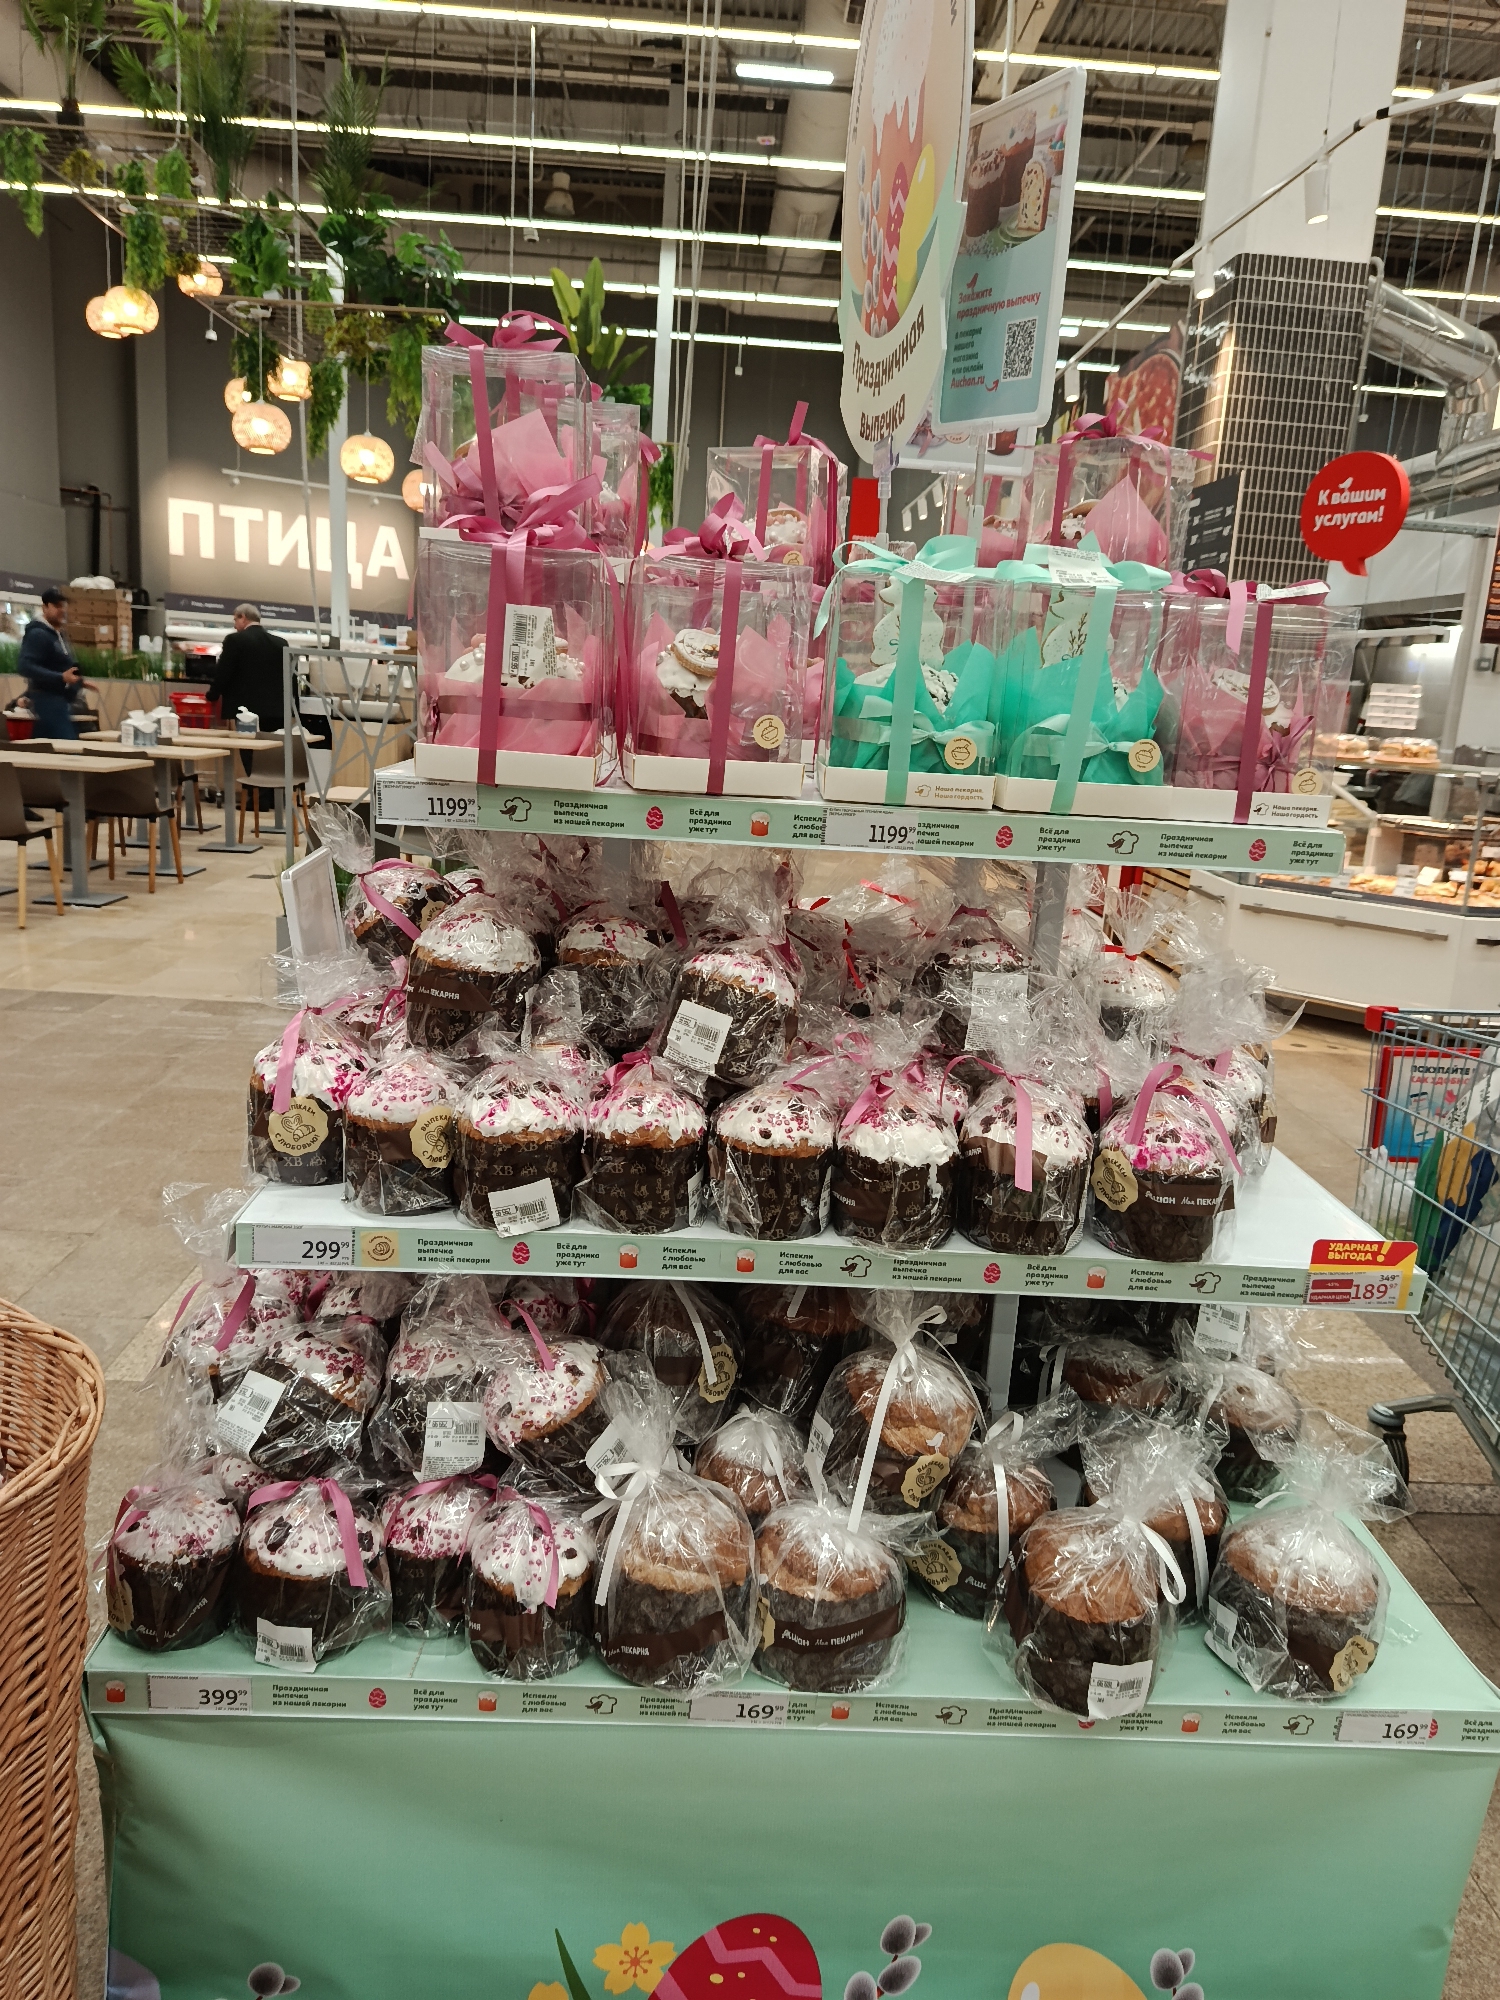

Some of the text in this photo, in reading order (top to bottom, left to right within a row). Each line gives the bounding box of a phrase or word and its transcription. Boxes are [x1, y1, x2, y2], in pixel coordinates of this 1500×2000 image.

[958, 287, 993, 305] Закажите
[956, 291, 1042, 320] праздничную выпечку
[852, 304, 925, 397] Праздничная
[950, 375, 985, 389] Auchan.ru
[859, 393, 906, 442] выпечка
[1317, 488, 1387, 506] К вашим
[1313, 505, 1385, 532] услугам!
[167, 497, 410, 590] ПТИЦА
[427, 797, 476, 817] 1199 99
[553, 800, 608, 811] Праздничная
[553, 810, 588, 818] выпечка
[689, 808, 703, 816] Всё
[563, 817, 625, 829] нашей пекарни
[688, 817, 732, 826] праздника
[688, 826, 703, 834] уже
[868, 824, 908, 844] 1199
[1038, 836, 1081, 845] праздника
[1160, 833, 1214, 843] Праздничная
[942, 840, 975, 848] пекарни
[1037, 844, 1052, 852] уже
[1159, 842, 1194, 850] выпечка
[1292, 840, 1306, 848] Всё
[1194, 853, 1228, 861] пекарни
[1290, 850, 1334, 858] праздника
[1289, 857, 1319, 866] уже тут
[288, 1102, 316, 1117] ПЕКАЕМ
[420, 1114, 451, 1132] ВЫПЕКА
[277, 1133, 321, 1151] ЛЮБОВЬЮ!
[417, 1238, 474, 1247] Праздничная
[301, 1240, 350, 1260] 299 99
[662, 1246, 697, 1255] Испекли
[1328, 1242, 1379, 1252] УДАРНАЯ
[556, 1252, 600, 1260] праздника
[667, 1255, 706, 1263] любовью
[779, 1252, 814, 1260] Испекли
[1327, 1251, 1373, 1262] ВЫГОДА
[555, 1260, 571, 1268] уже
[661, 1263, 677, 1271] для
[784, 1260, 823, 1268] любовью
[893, 1259, 948, 1267] Праздничная
[1026, 1263, 1041, 1271] Всё
[1025, 1272, 1069, 1280] праздника
[1130, 1268, 1164, 1277] Испекли
[929, 1276, 962, 1284] пекарни
[1134, 1277, 1173, 1285] любовью
[1242, 1274, 1296, 1284] Праздничная
[1379, 1274, 1397, 1282] 349
[1024, 1279, 1040, 1287] уже
[1241, 1282, 1276, 1290] выпечка
[1127, 1284, 1143, 1292] для
[1351, 1283, 1388, 1300] 189
[1250, 1290, 1276, 1298] нашей
[620, 1644, 650, 1656] ПЕКАРНЯ
[272, 1684, 329, 1693] Праздничная
[199, 1689, 238, 1706] 399
[522, 1692, 557, 1700] Испекли
[312, 1701, 347, 1709] пекарни
[413, 1697, 458, 1705] праздника
[875, 1701, 910, 1710] Испекли
[735, 1703, 774, 1720] 169
[879, 1709, 918, 1717] любовью
[989, 1707, 1043, 1715] Праздничная
[1224, 1713, 1258, 1721] Испекли
[996, 1720, 1057, 1729] нашей пекарни
[1120, 1718, 1163, 1726] праздника
[1228, 1720, 1266, 1728] любовью
[1463, 1718, 1477, 1726] Всё
[1221, 1727, 1238, 1735] для
[1381, 1723, 1419, 1740] 169
[1460, 1734, 1477, 1742] уже
